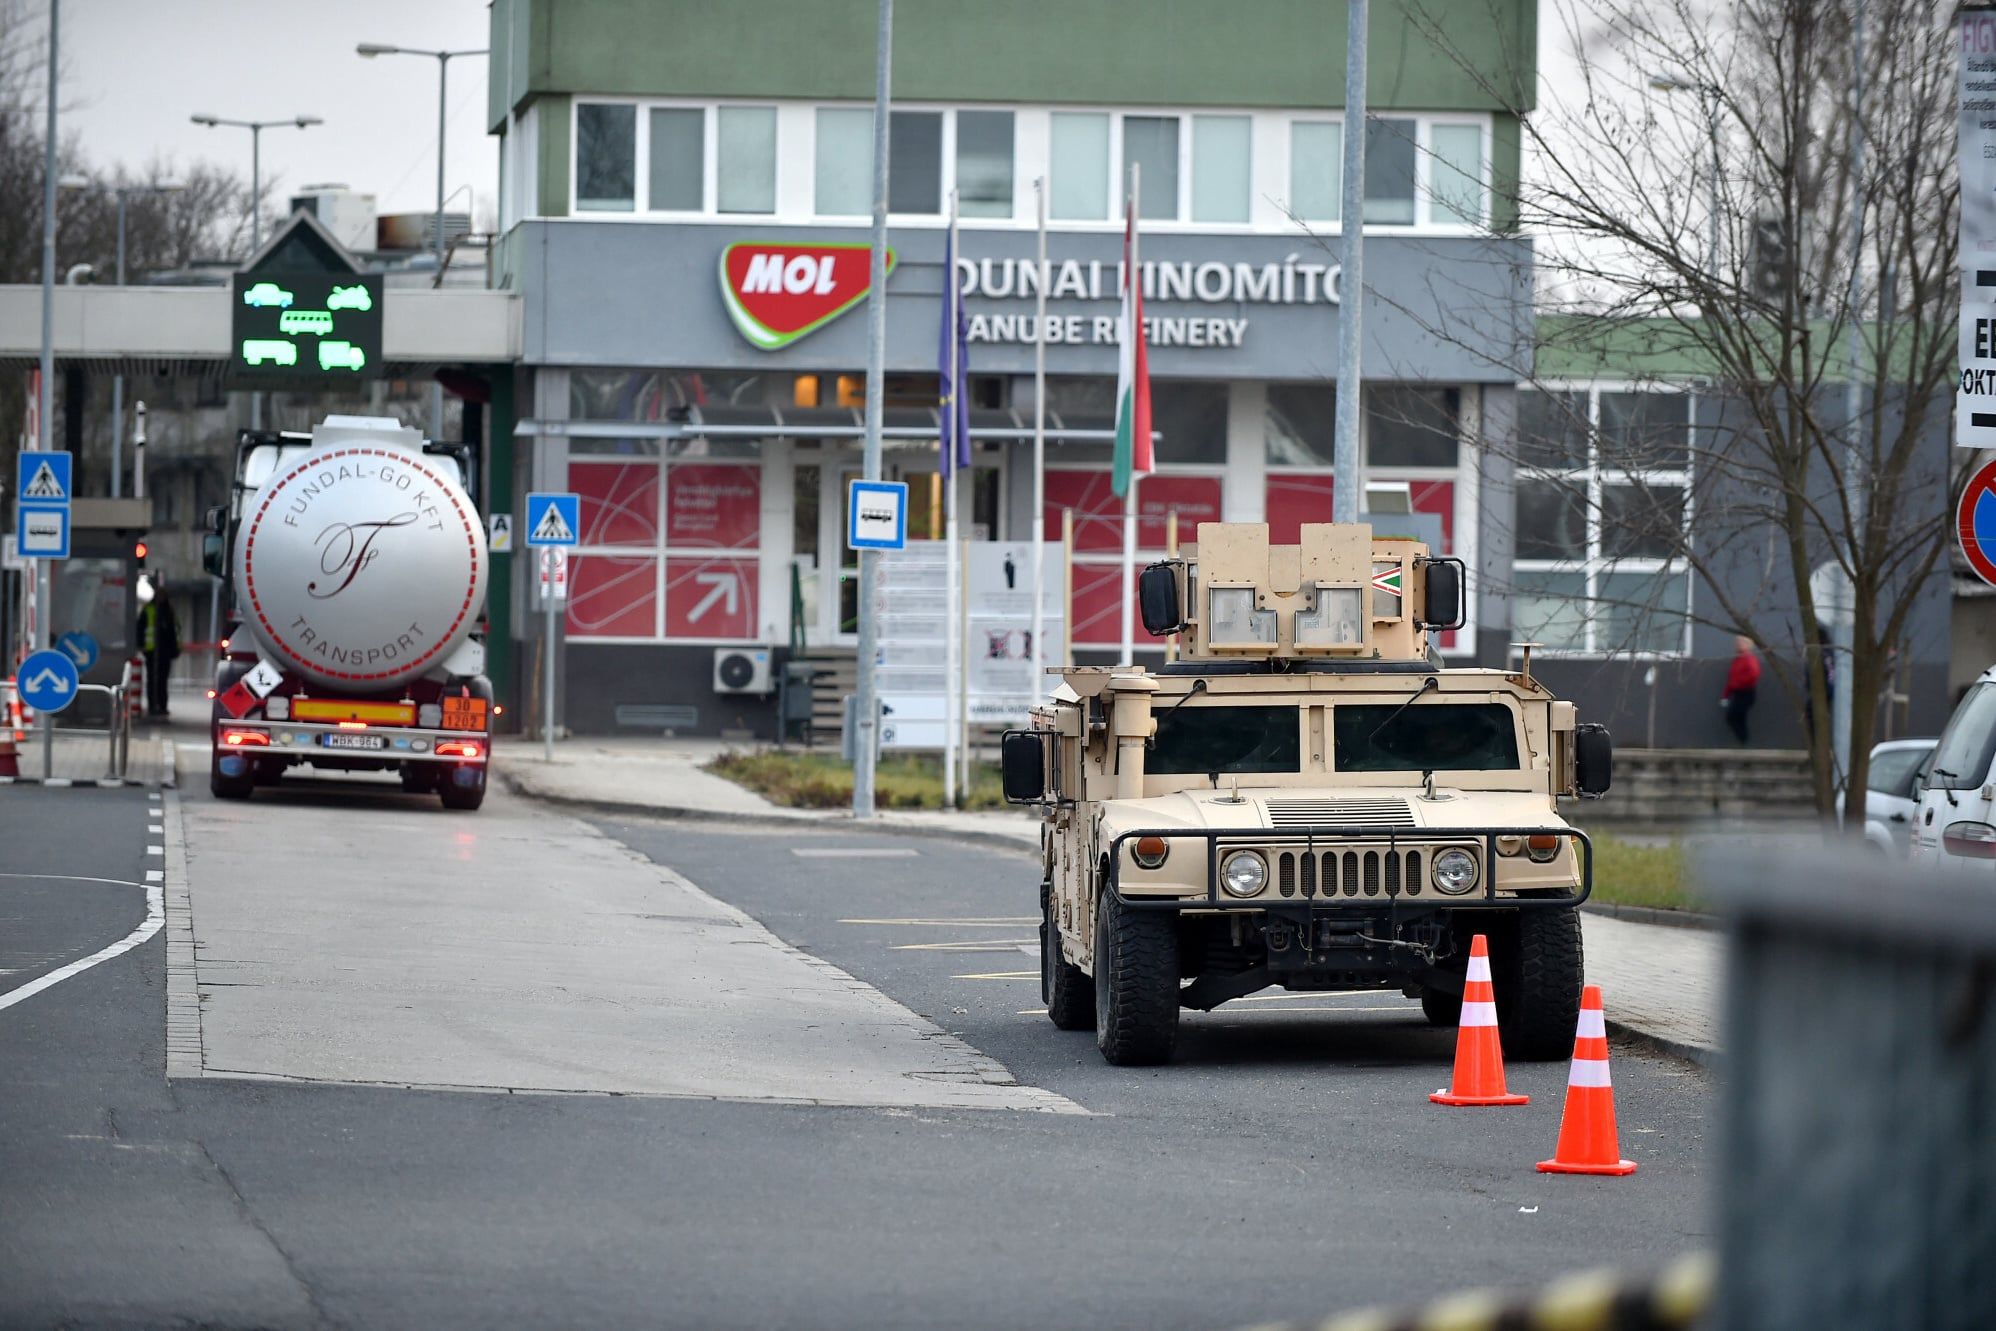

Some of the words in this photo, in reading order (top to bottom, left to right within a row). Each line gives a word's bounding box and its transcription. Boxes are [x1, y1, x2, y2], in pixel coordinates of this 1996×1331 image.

[741, 253, 837, 295] MOL
[957, 257, 1101, 299] DUNAI
[1117, 253, 1341, 303] INOMÍT
[966, 314, 1083, 344] ANUBE
[1960, 368, 1996, 396] OKT
[284, 463, 411, 528] FUNDAL-GO
[413, 490, 444, 532] KFT
[494, 516, 508, 531] A
[291, 614, 424, 665] TRANSPORT
[456, 699, 470, 711] 30
